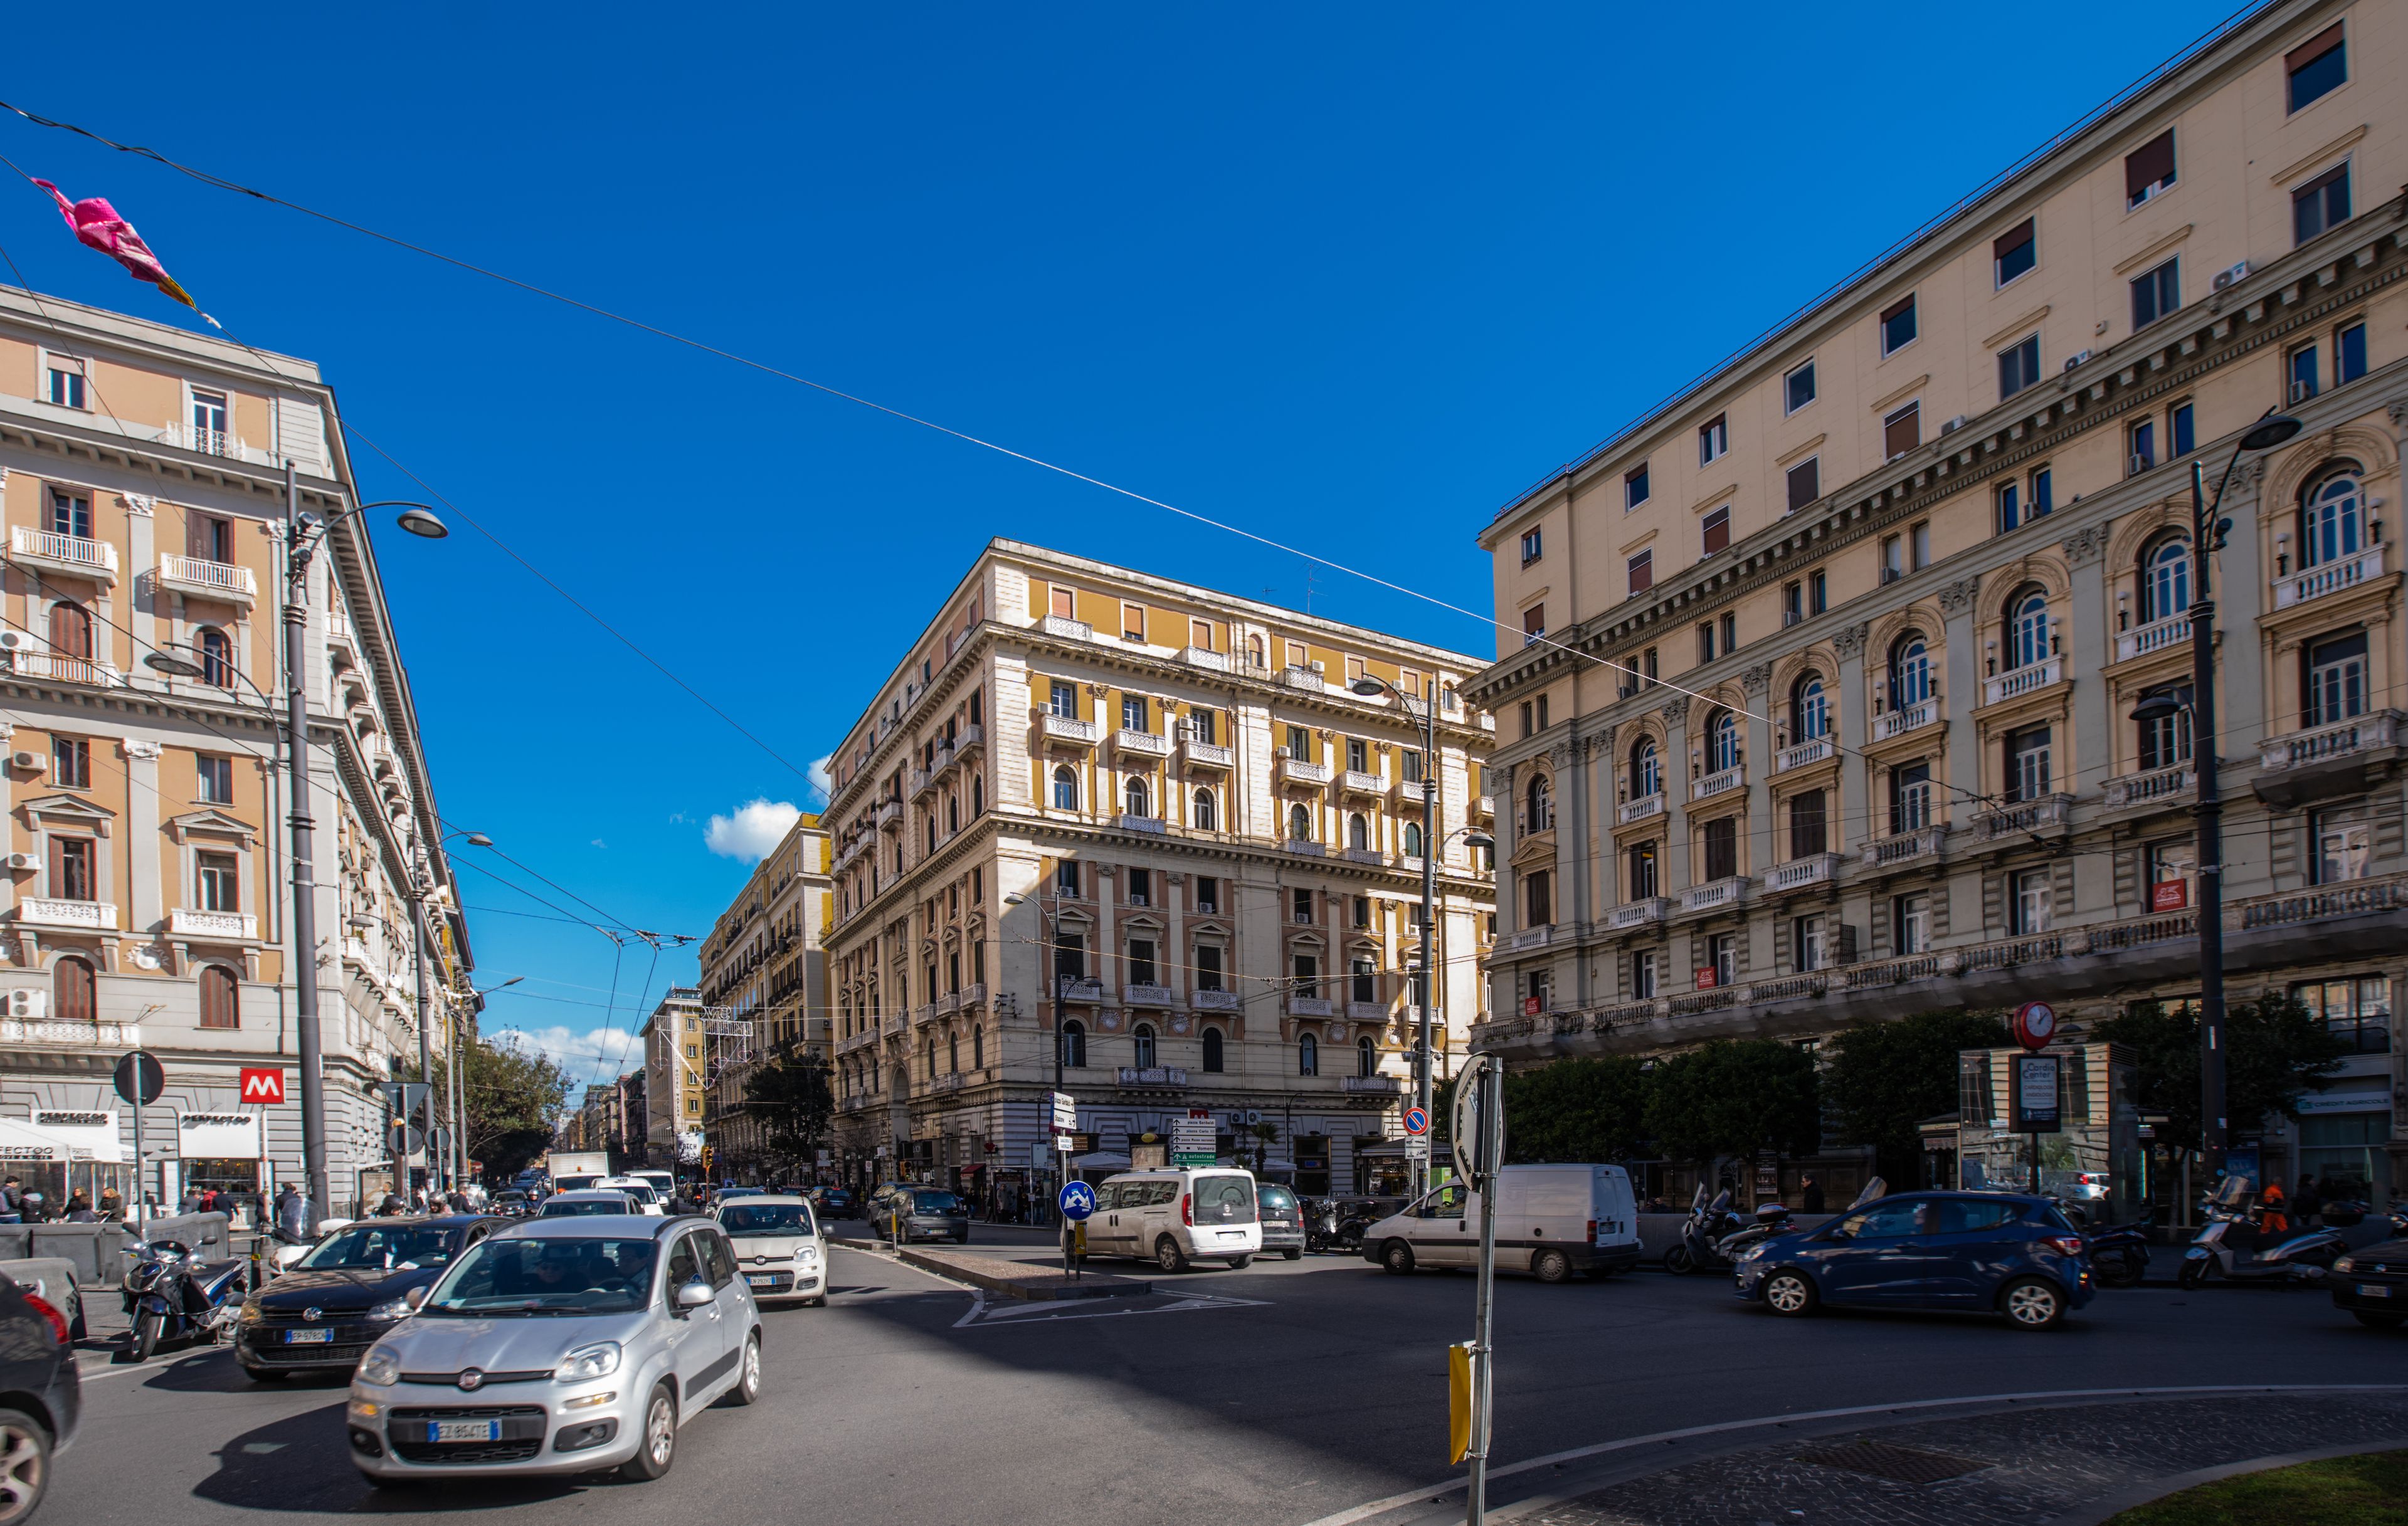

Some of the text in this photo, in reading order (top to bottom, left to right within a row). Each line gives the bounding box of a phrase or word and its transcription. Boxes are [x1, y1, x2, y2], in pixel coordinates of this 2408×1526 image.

[2028, 1063, 2056, 1071] Cardio
[2023, 1070, 2051, 1078] Center
[245, 1076, 280, 1096] M
